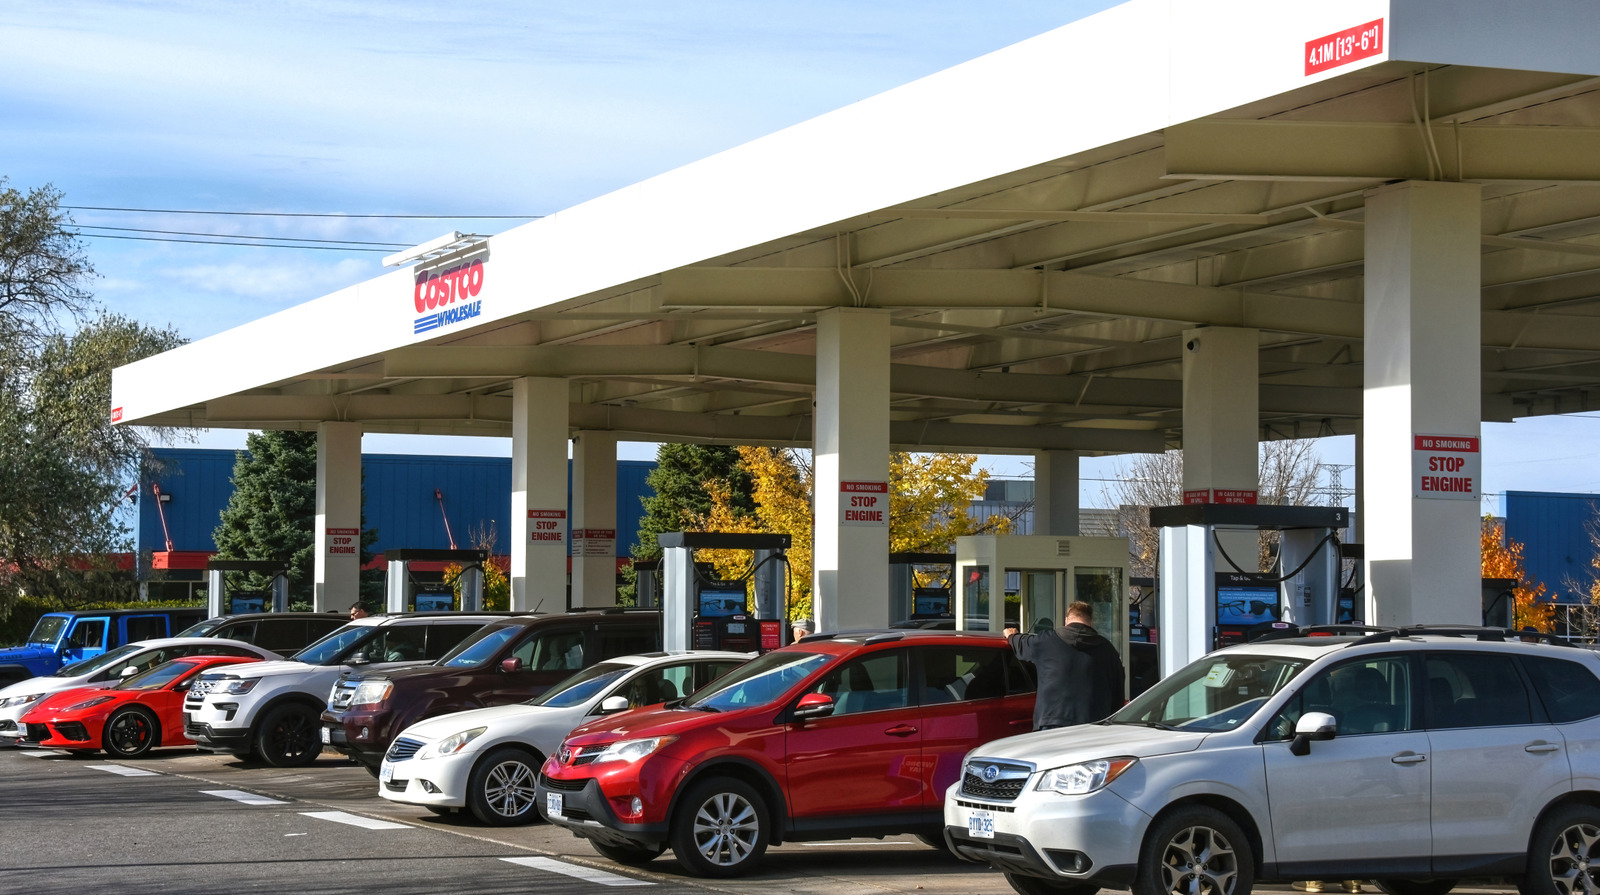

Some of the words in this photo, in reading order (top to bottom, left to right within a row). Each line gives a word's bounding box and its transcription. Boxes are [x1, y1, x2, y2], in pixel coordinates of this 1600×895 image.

[1309, 42, 1334, 66] 4.1M
[414, 259, 484, 313] COSTCO
[437, 300, 482, 327] WHOLESALE
[1422, 439, 1433, 448] NO
[1436, 440, 1471, 449] SMOKING
[1429, 456, 1465, 472] STOP
[1421, 476, 1472, 493] ENGINE
[851, 496, 877, 507] STOP
[845, 510, 883, 521] ENGINE
[1336, 513, 1341, 521] 3
[536, 521, 557, 530] STOP
[333, 537, 352, 545] STOP
[531, 532, 562, 541] ENGINE
[329, 546, 356, 554] ENGINE
